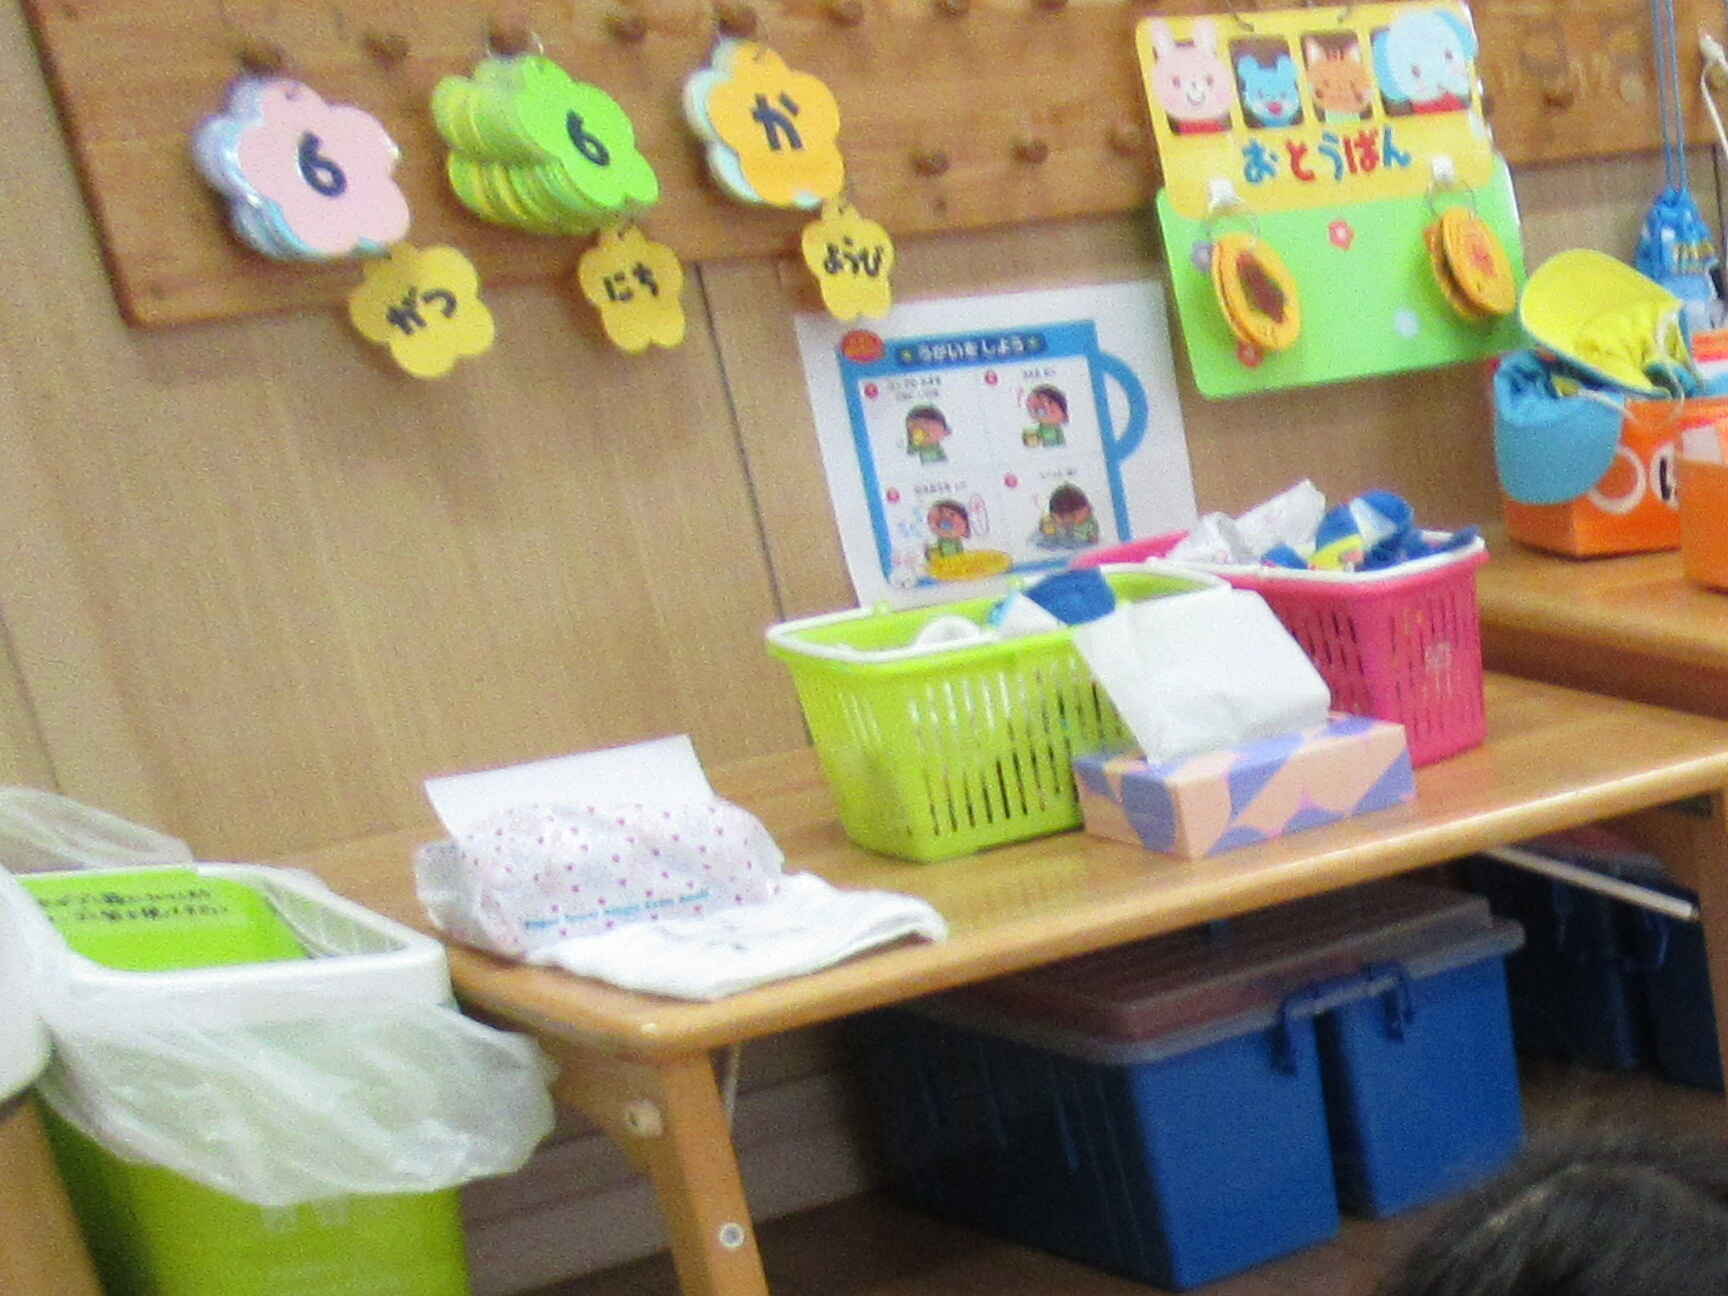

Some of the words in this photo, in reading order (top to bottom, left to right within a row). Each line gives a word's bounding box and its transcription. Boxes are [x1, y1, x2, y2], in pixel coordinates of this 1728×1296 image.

[566, 109, 610, 166] 6
[752, 91, 803, 150] か
[298, 131, 348, 197] 6
[1241, 122, 1412, 184] おとうばん
[386, 286, 457, 335] がつ
